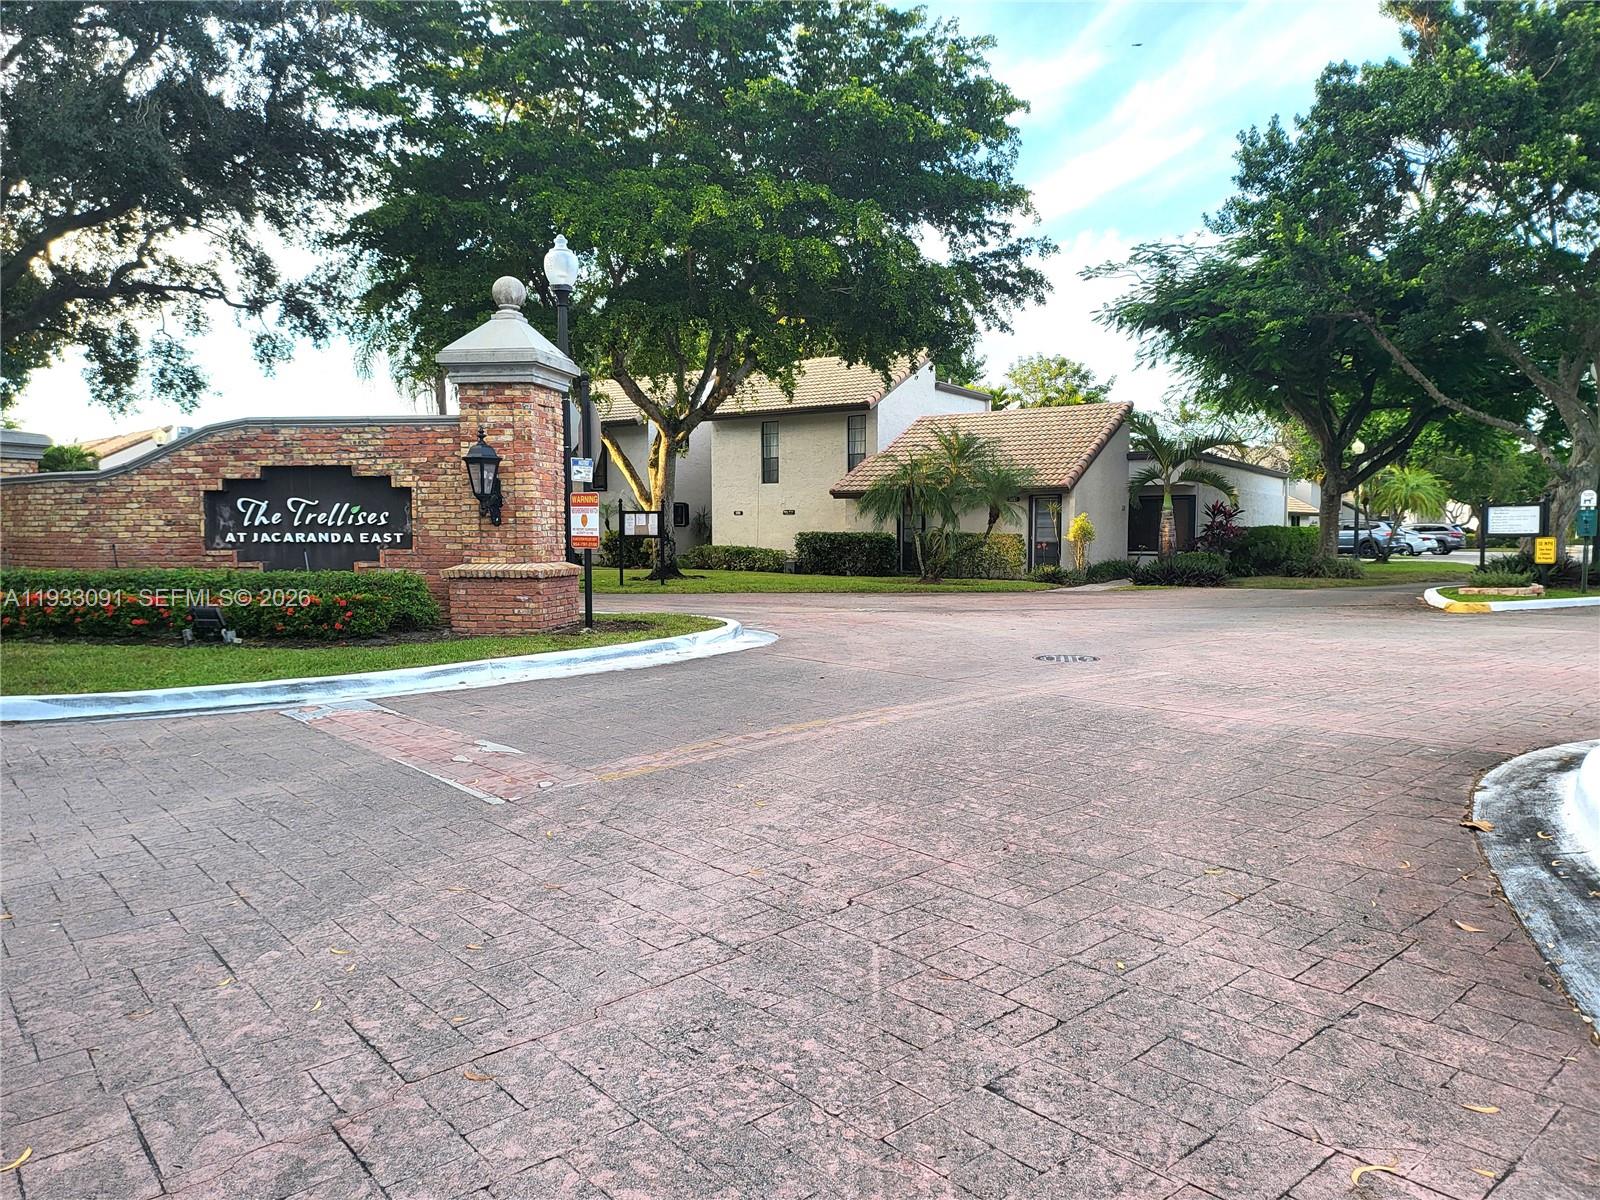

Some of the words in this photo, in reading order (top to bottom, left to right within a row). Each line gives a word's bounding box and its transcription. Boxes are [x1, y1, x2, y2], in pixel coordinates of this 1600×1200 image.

[572, 495, 598, 504] WARNING
[236, 497, 282, 526] The
[286, 497, 390, 526] Trellises
[225, 532, 247, 543] AT
[252, 532, 354, 543] JACARANDA
[359, 532, 404, 543] EAST
